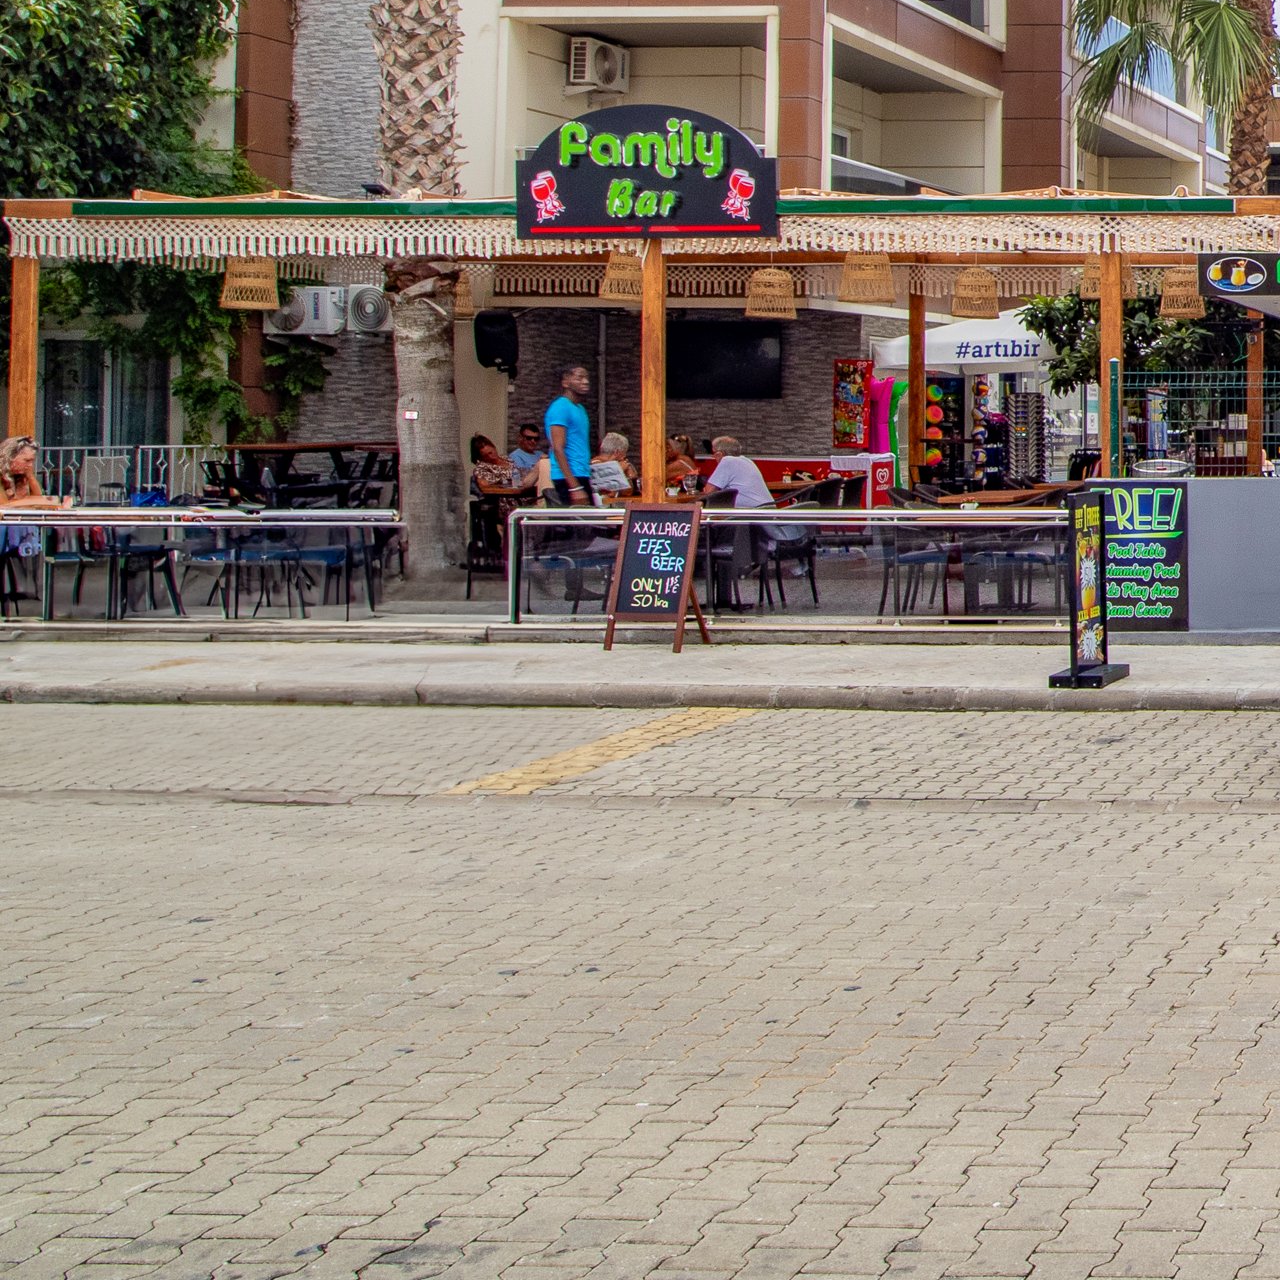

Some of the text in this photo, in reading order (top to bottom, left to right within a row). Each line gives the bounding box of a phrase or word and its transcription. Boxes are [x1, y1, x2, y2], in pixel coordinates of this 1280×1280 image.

[606, 178, 677, 218] Bar
[637, 538, 671, 556] EFES
[1108, 543, 1167, 559] Pool Table
[651, 555, 685, 572] BEER
[1153, 562, 1181, 578] Pool
[631, 577, 663, 595] ONLY
[1122, 582, 1149, 600] Play
[1150, 582, 1179, 600] Area
[1135, 601, 1173, 618] Center
